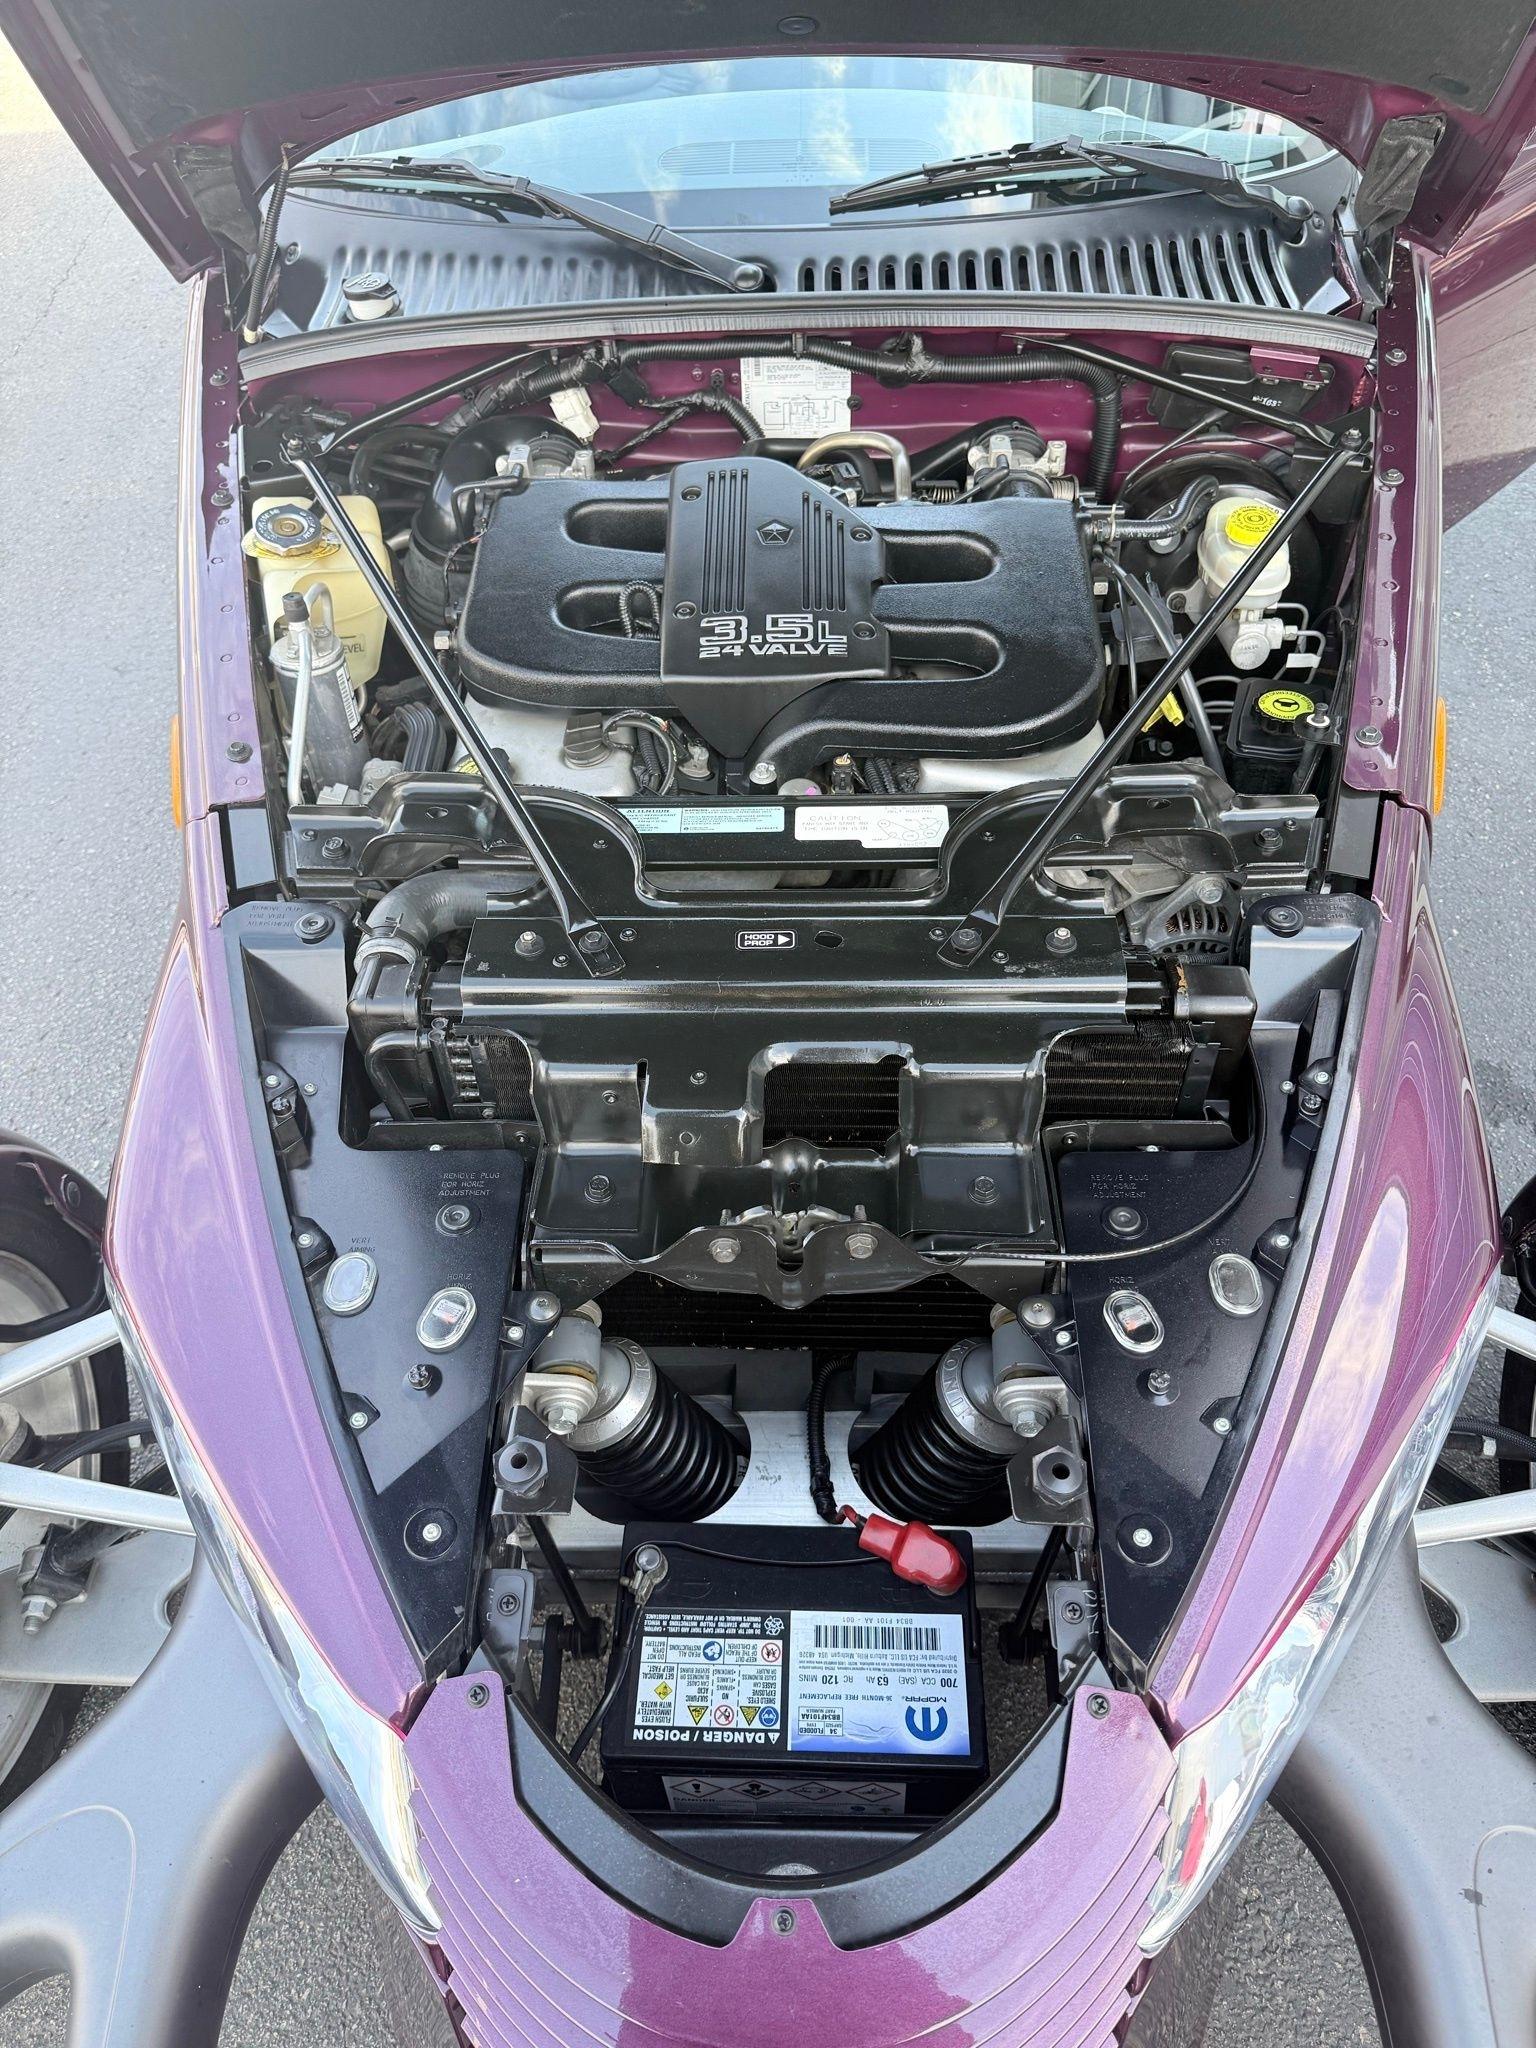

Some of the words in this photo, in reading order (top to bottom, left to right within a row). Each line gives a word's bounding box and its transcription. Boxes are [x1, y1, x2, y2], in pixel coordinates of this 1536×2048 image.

[700, 614, 848, 646] 3.5L
[343, 644, 364, 654] EVEL
[699, 644, 744, 658] 24
[748, 644, 848, 658] VALVE
[822, 1675, 839, 1684] 120
[877, 1676, 889, 1686] 63
[898, 1676, 917, 1685] (SAE)
[921, 1677, 936, 1685] CCA
[940, 1678, 958, 1688] 700
[633, 1729, 690, 1740] POISON
[694, 1730, 699, 1741] /
[703, 1731, 765, 1743] DANGER
